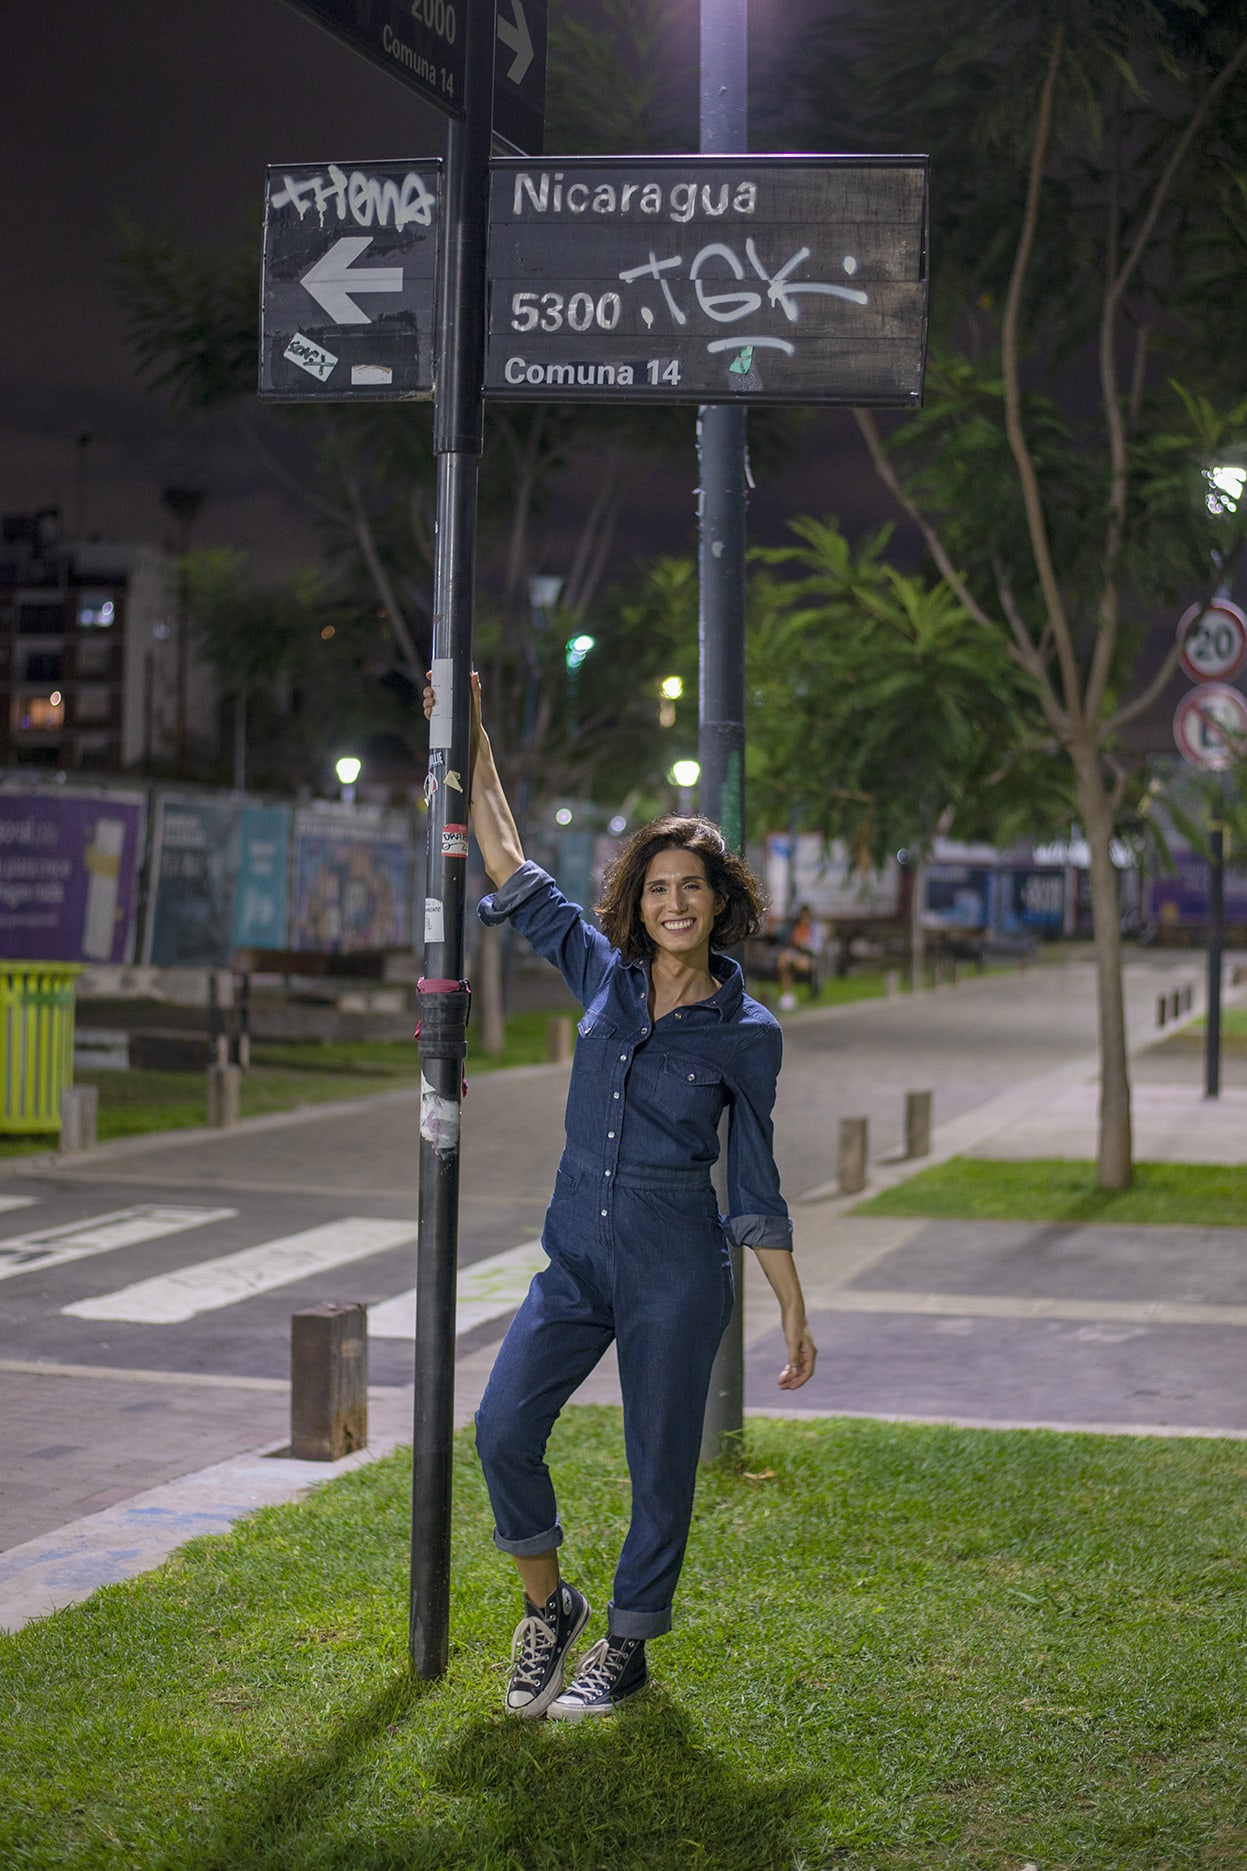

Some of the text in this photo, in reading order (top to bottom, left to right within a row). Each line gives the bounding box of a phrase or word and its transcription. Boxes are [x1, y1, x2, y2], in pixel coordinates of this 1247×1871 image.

[383, 24, 454, 98] Comuna 14
[513, 173, 757, 223] Nicaragua
[511, 292, 621, 332] 5300
[504, 357, 682, 386] Comuna 14
[1195, 624, 1234, 661] 20
